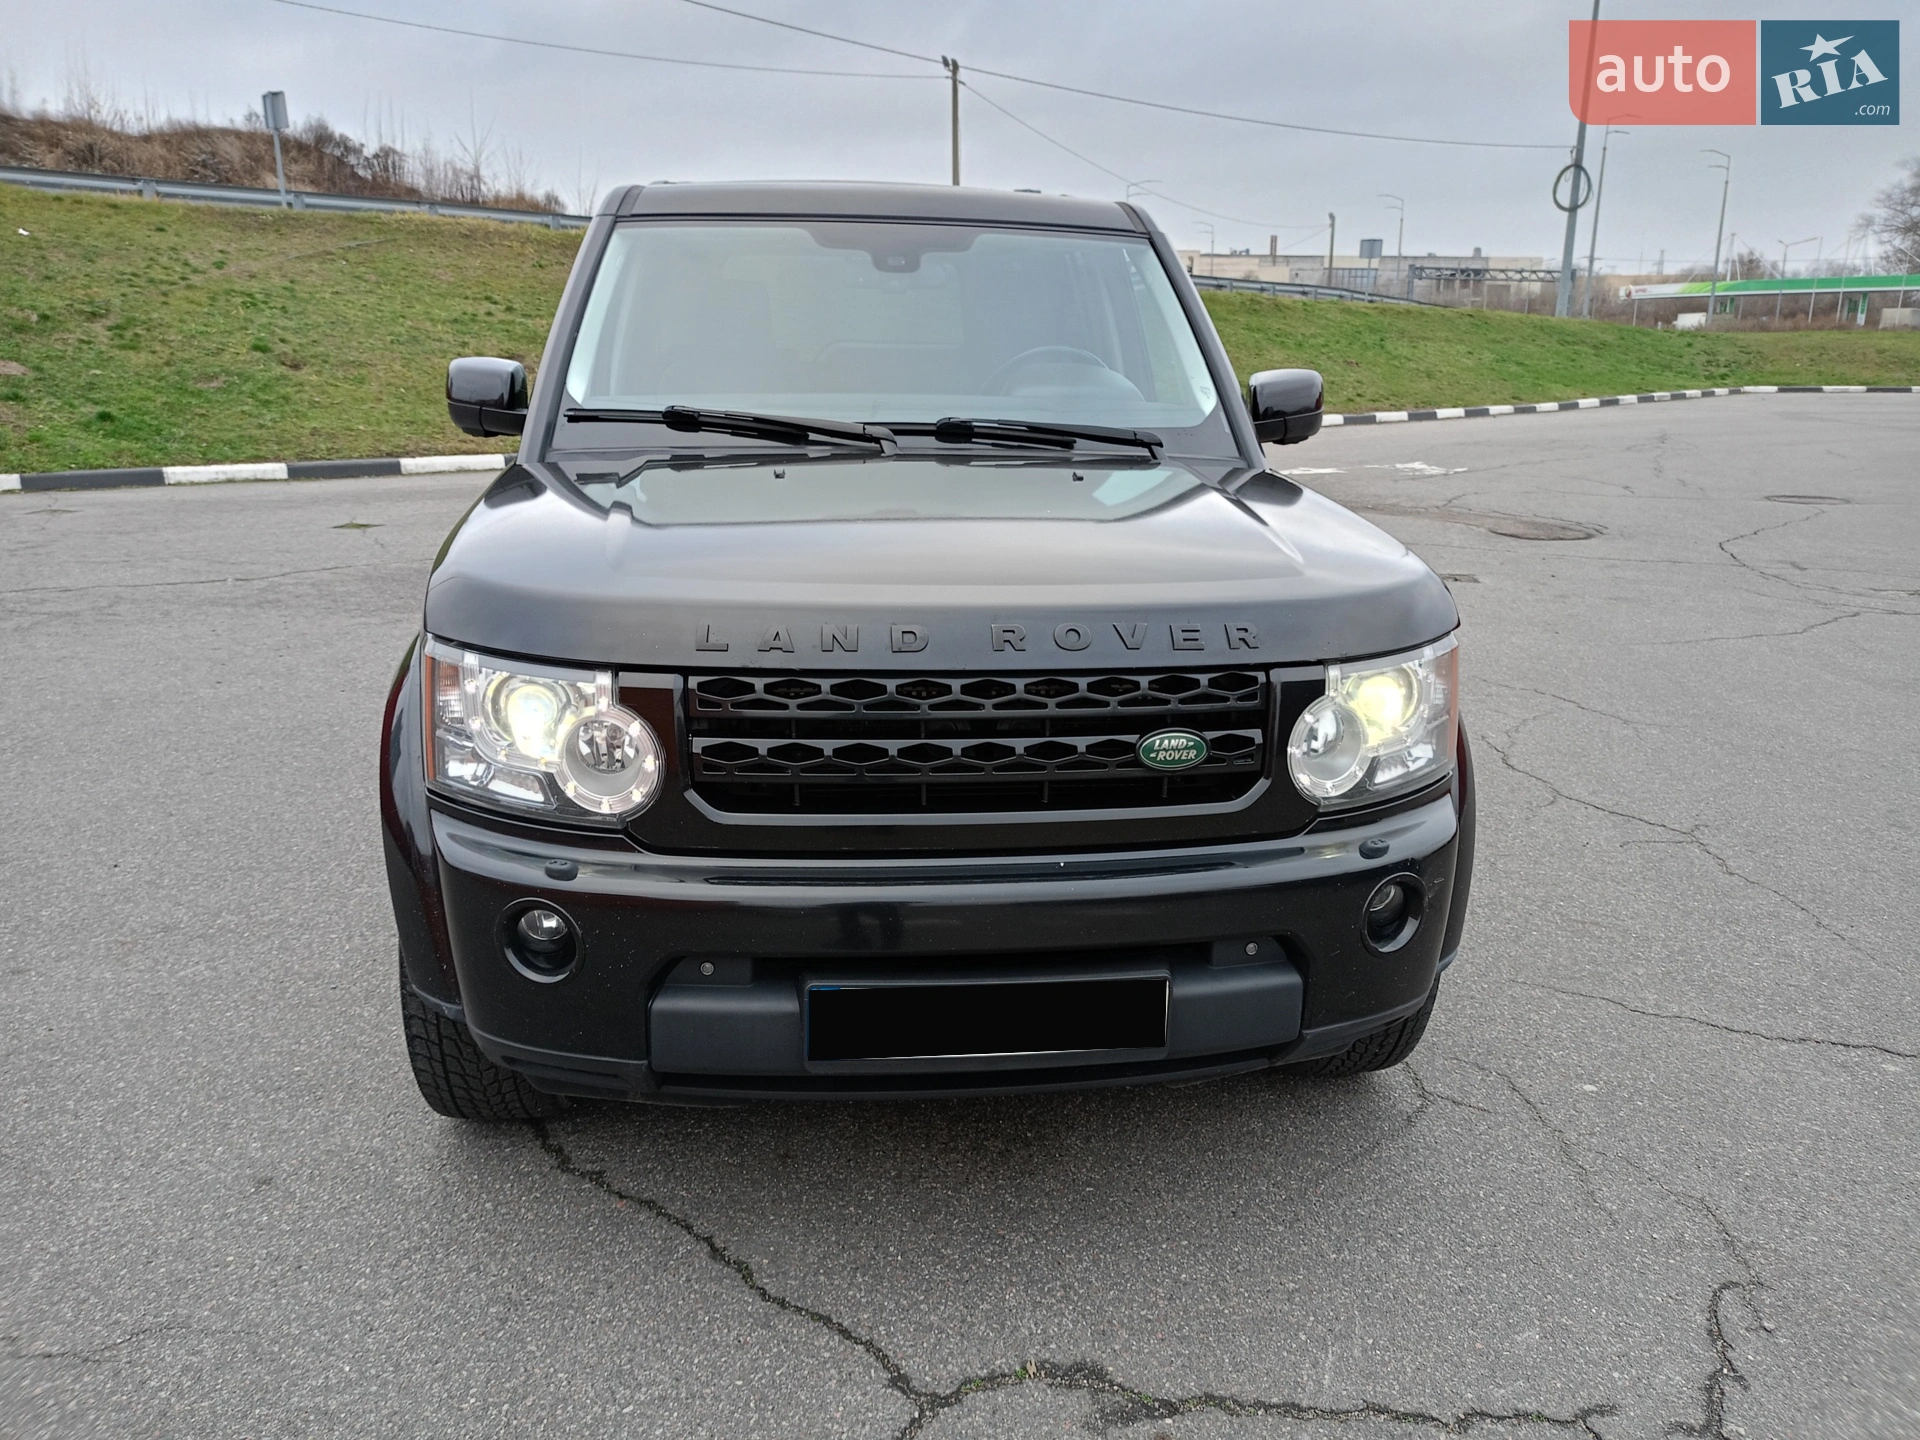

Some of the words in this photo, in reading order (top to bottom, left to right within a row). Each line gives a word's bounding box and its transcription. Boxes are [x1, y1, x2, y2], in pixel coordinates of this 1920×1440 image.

[695, 623, 930, 653] LAND
[991, 621, 1260, 652] ROVER
[1153, 738, 1187, 750] LAND
[1156, 749, 1197, 761] ROVER
